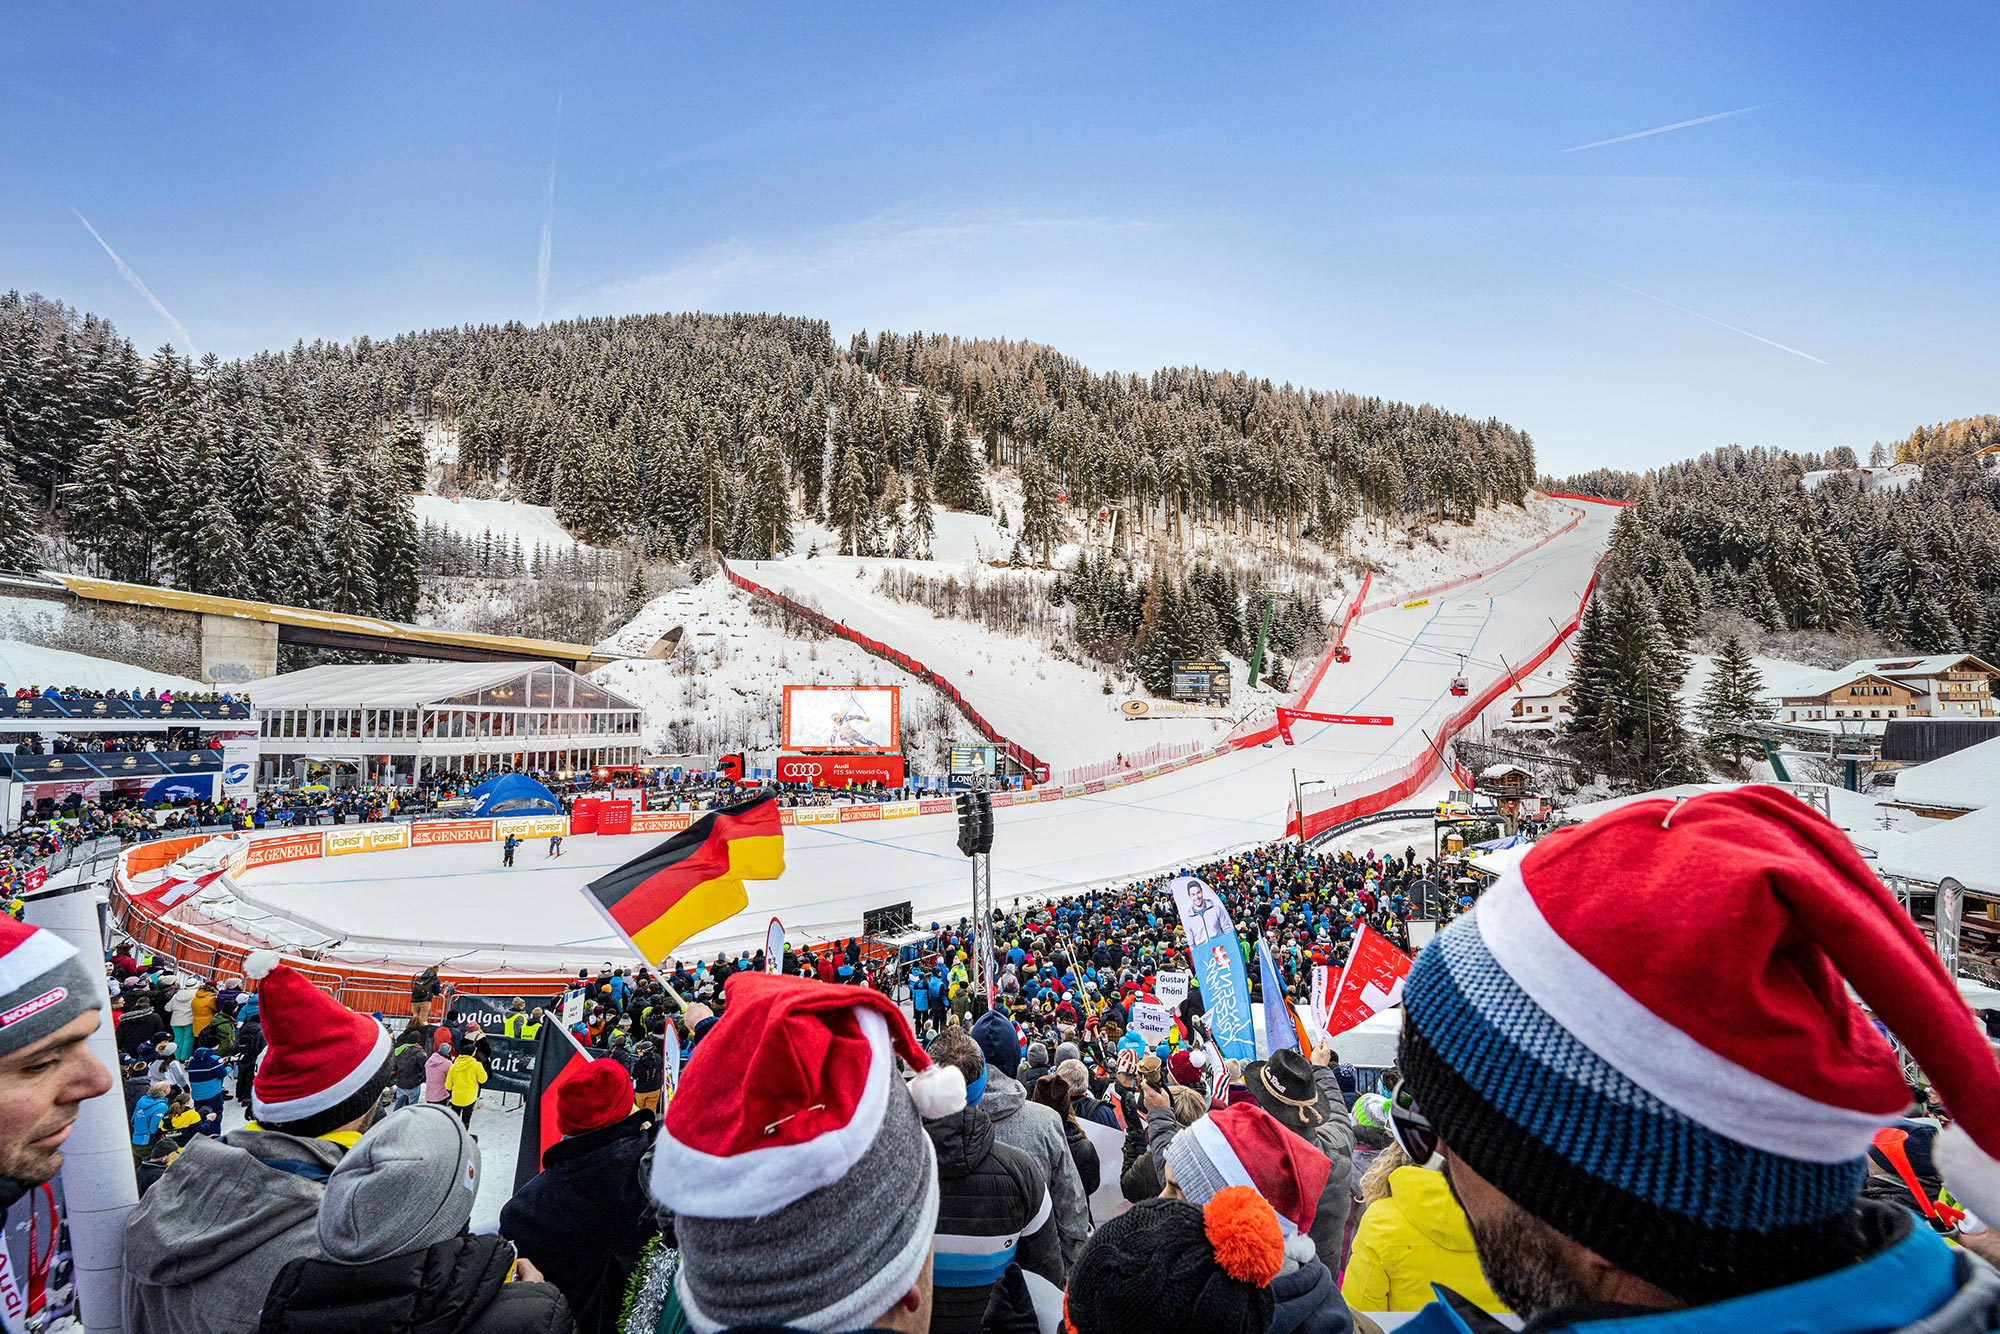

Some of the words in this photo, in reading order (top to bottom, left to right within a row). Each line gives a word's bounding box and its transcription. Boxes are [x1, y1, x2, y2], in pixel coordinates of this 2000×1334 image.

[1154, 704, 1199, 712] CANDIDATE
[850, 811, 880, 820] GENERALI
[501, 825, 527, 835] FORST
[536, 822, 561, 832] FORST
[645, 820, 690, 831] GENERALI
[373, 833, 401, 844] FORST
[432, 828, 491, 842] GENERALI
[332, 836, 362, 848] FORST
[264, 842, 321, 862] GENERALI
[1160, 975, 1186, 984] Gustav
[1161, 987, 1183, 995] Thöni
[1142, 1012, 1161, 1021] Toni
[1140, 1022, 1164, 1033] Sailer
